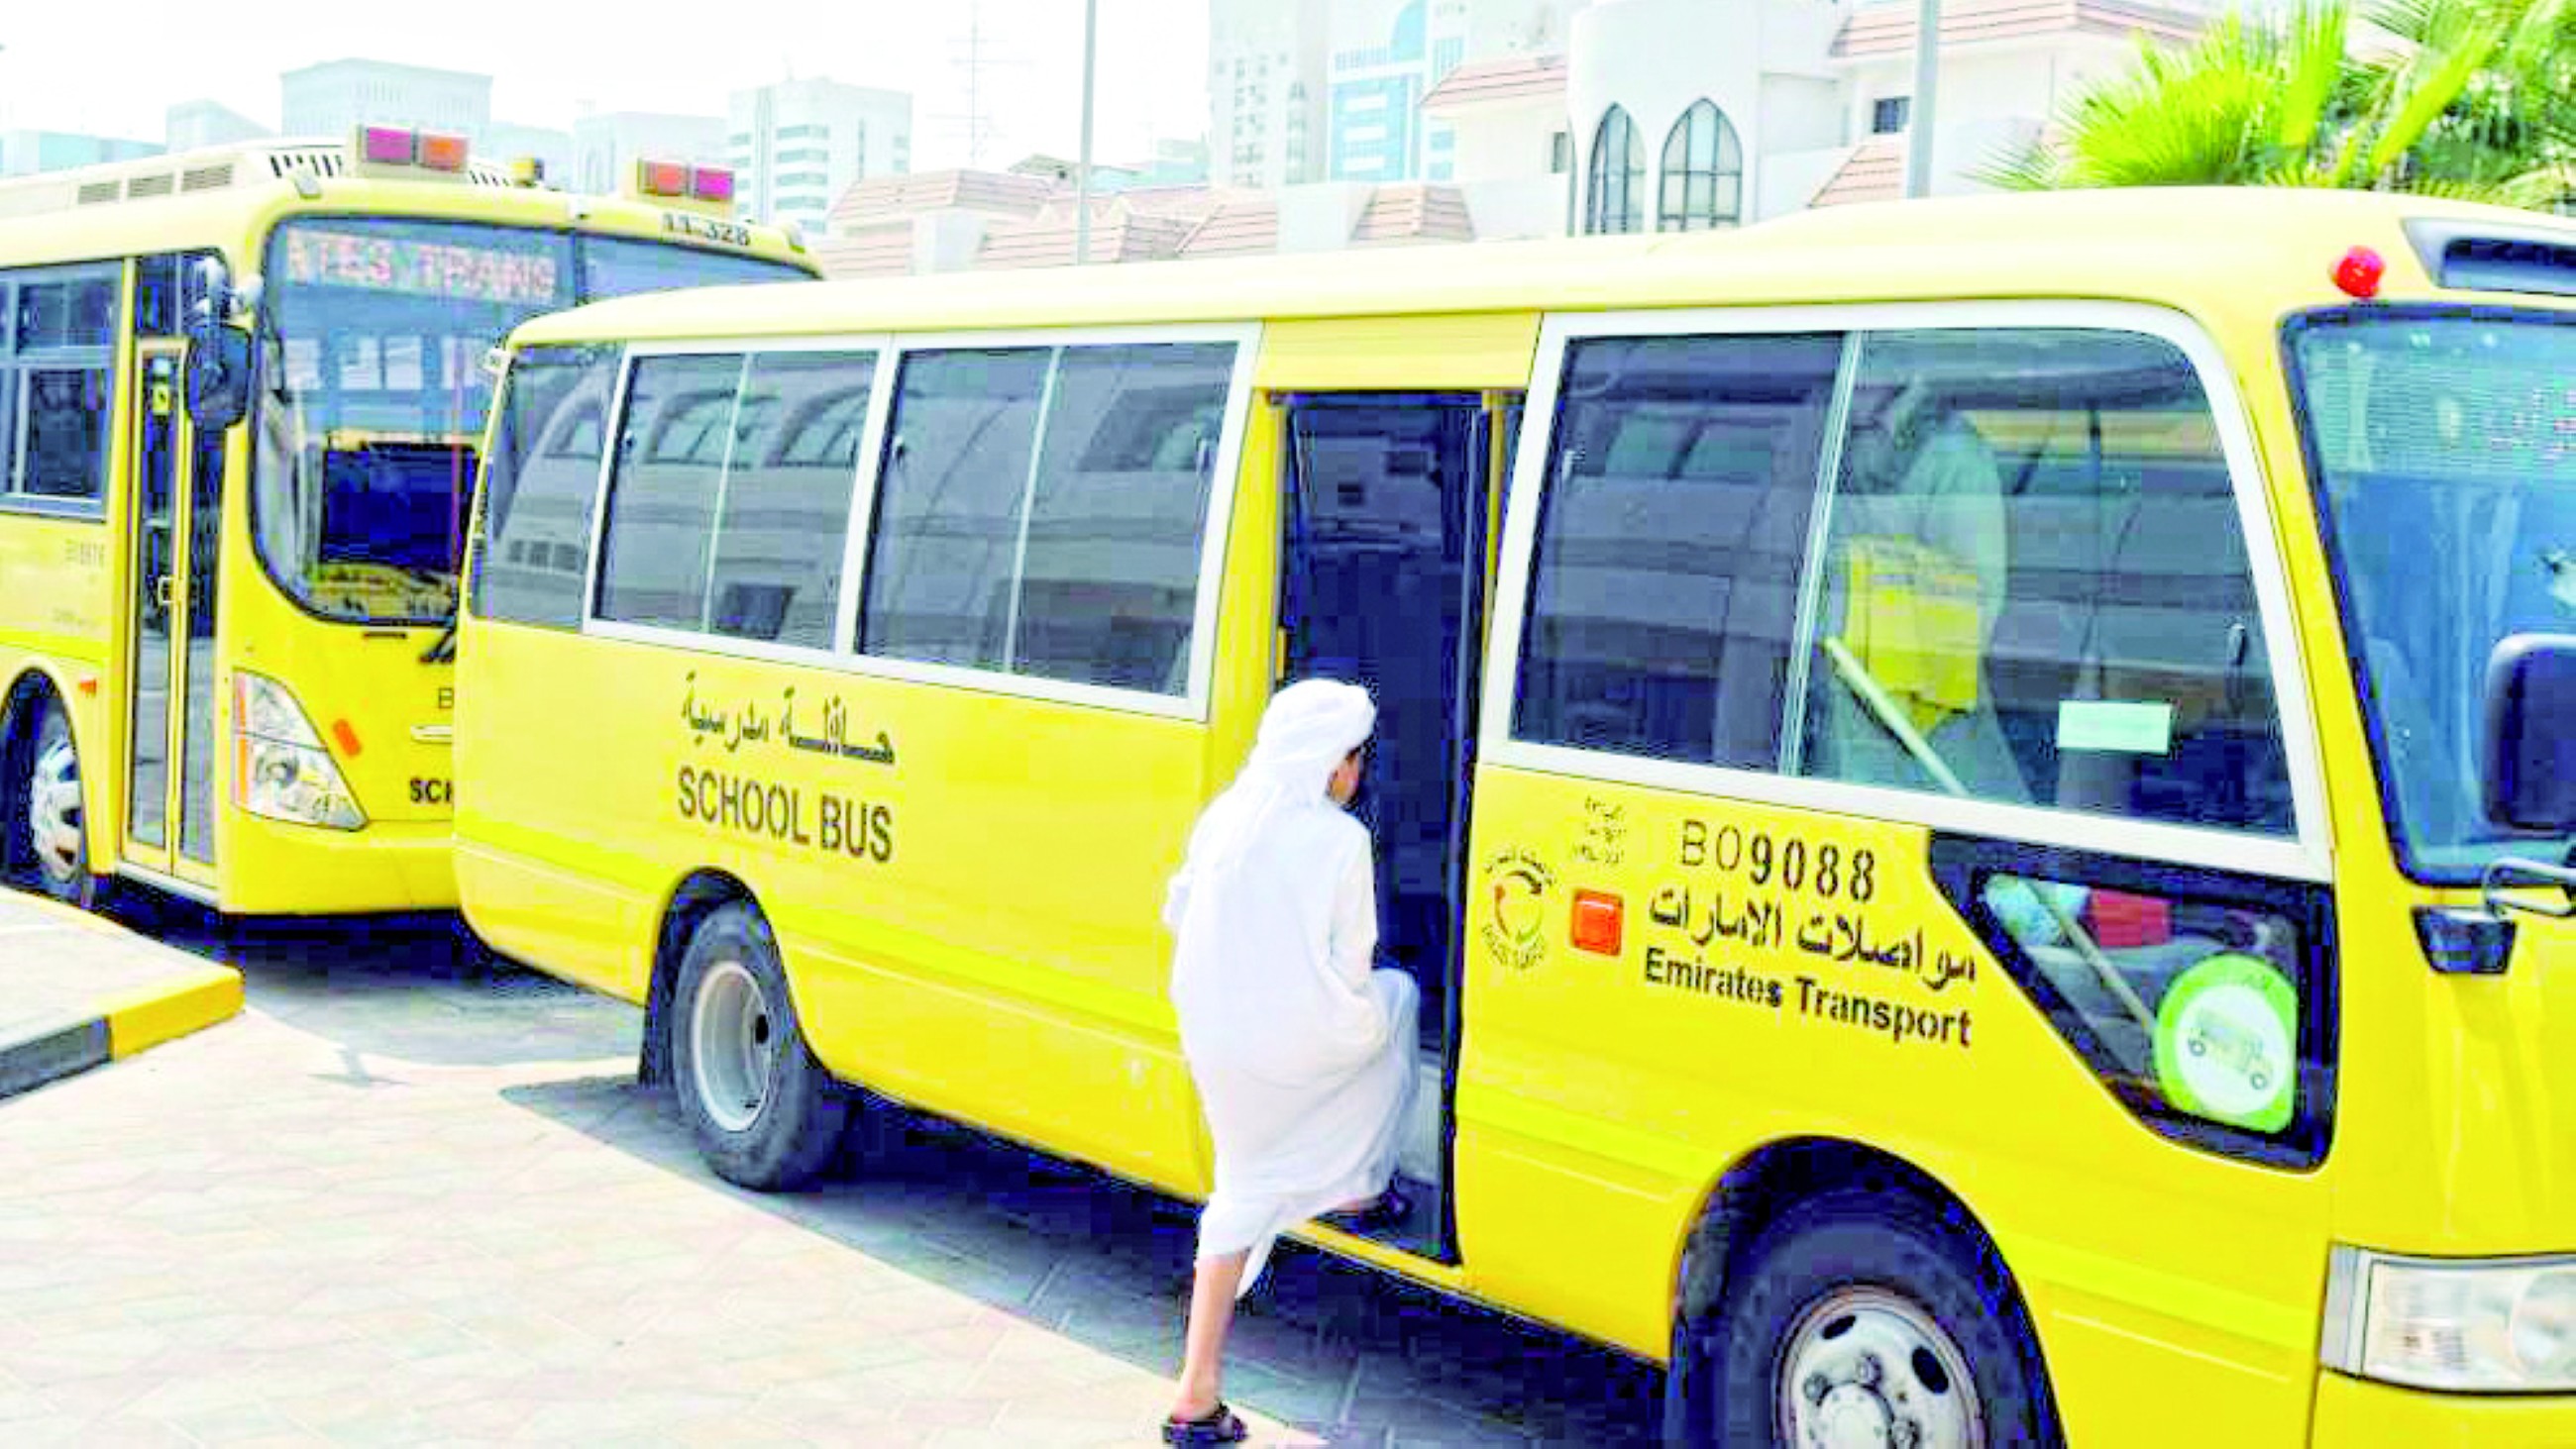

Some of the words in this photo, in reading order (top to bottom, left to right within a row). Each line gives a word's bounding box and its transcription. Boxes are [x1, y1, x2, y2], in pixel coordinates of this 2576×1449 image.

[681, 670, 770, 753] مدرسية
[778, 685, 897, 766] حافلة
[678, 766, 811, 846] SCHOOL
[819, 793, 893, 864] BUS
[1644, 945, 1783, 1009] Emirates
[1794, 975, 1974, 1048] Transport
